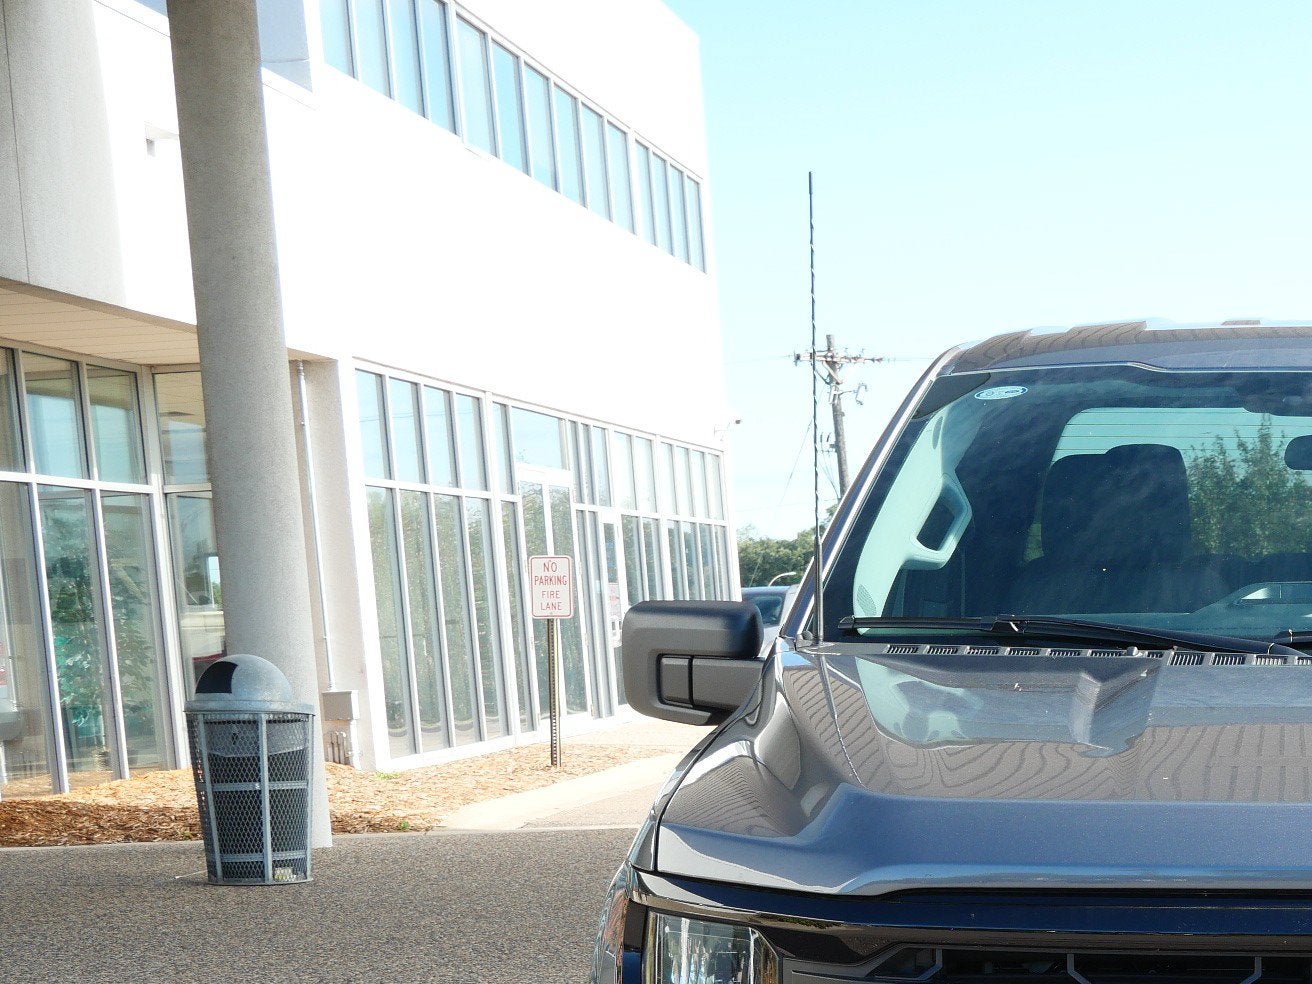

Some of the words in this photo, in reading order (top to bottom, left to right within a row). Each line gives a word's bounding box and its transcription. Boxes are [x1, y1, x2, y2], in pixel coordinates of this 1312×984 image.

[543, 562, 558, 573] NO
[534, 575, 568, 586] PARKING
[541, 590, 561, 599] FIRE
[540, 602, 563, 611] LANE
